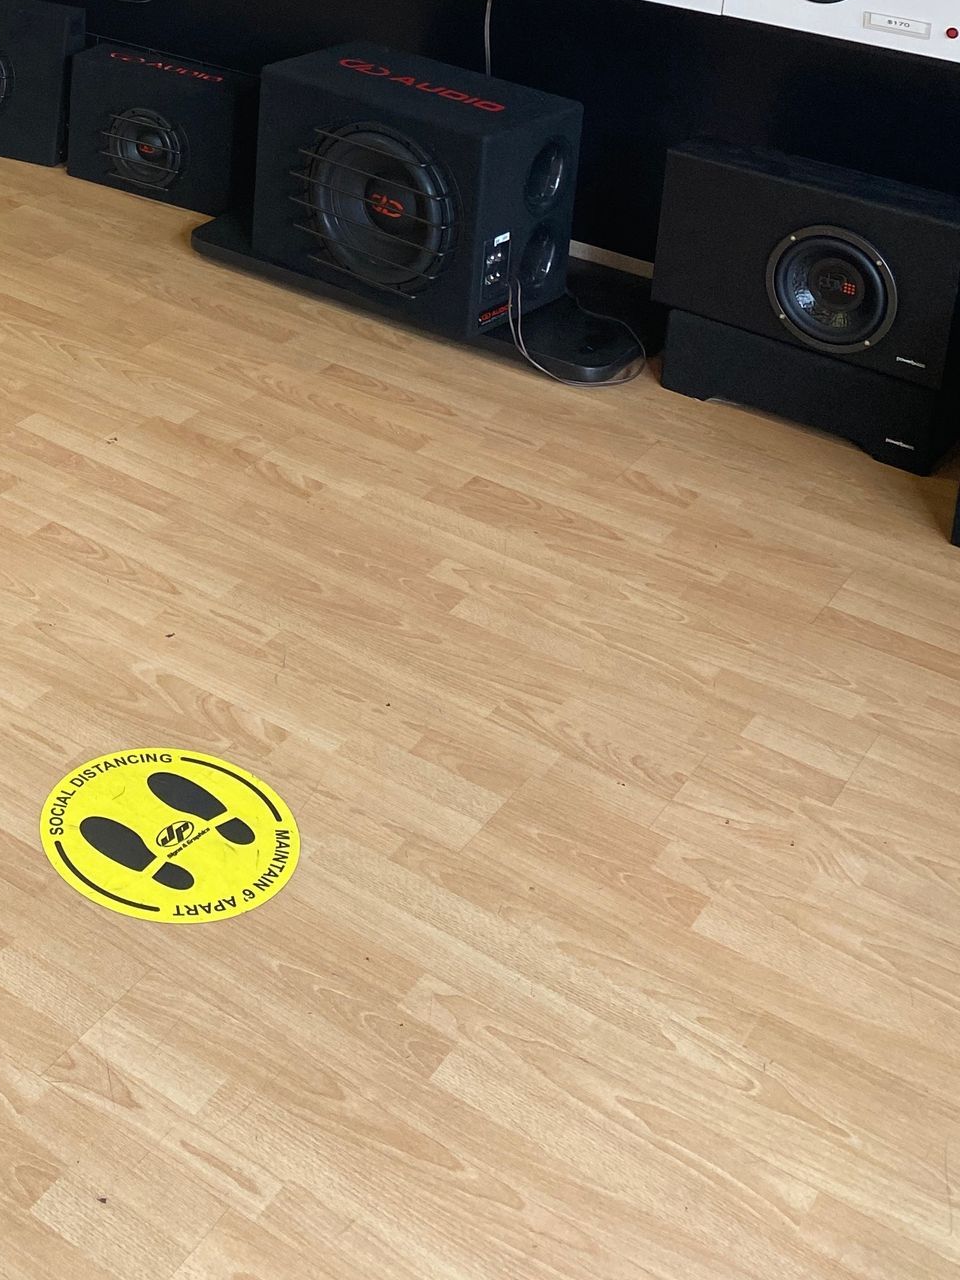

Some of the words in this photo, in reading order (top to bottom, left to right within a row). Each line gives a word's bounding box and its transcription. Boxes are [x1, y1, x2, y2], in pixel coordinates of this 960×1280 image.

[148, 61, 224, 83] AUDIO
[390, 76, 506, 112] AUDIO
[50, 789, 76, 836] SOCIAL
[70, 753, 173, 788] DISTANCING
[254, 828, 289, 892] MAINTAIN
[172, 895, 237, 916] APART
[242, 888, 257, 903] 6'
